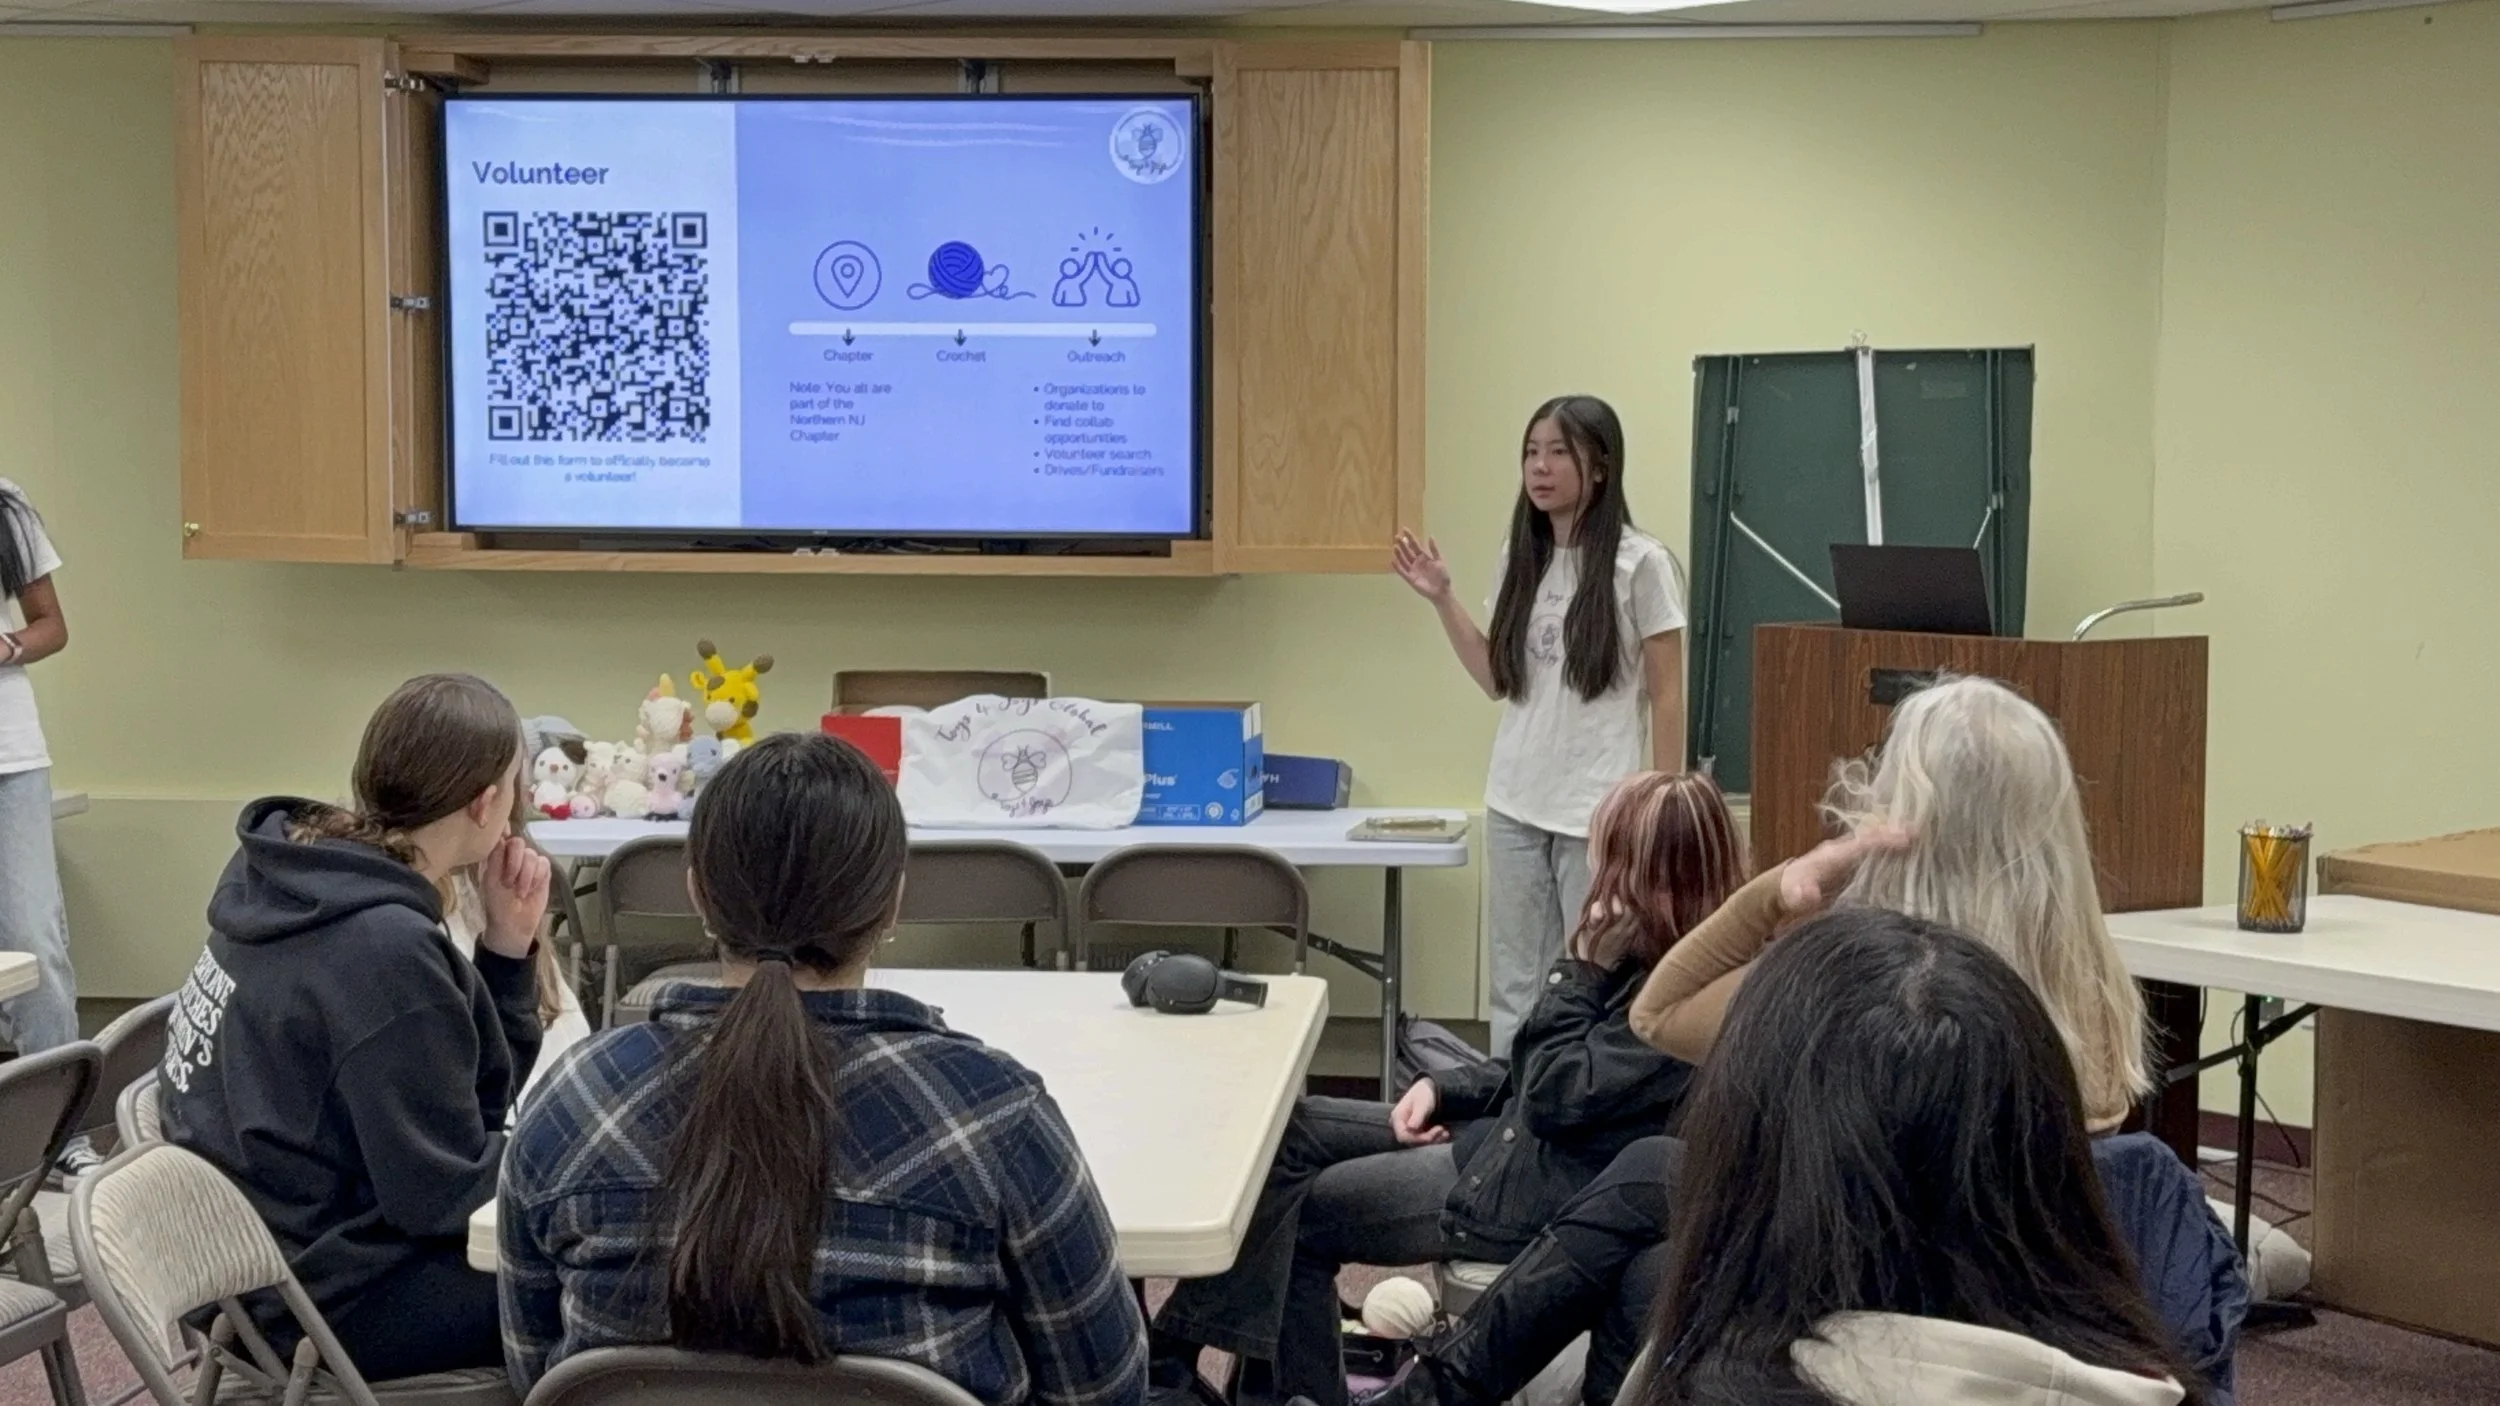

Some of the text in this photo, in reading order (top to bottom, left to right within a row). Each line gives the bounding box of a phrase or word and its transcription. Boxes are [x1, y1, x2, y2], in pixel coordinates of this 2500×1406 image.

[472, 160, 609, 185] Volunteer
[823, 349, 874, 363] Chapter
[936, 350, 986, 363] Crochet
[1067, 350, 1126, 363] Outreach
[825, 382, 851, 394] You
[853, 382, 868, 394] all
[872, 383, 892, 394] are
[1044, 384, 1146, 398] Organizations to
[789, 398, 855, 411] part of the
[1044, 400, 1105, 412] donate to
[789, 414, 865, 426] Northern NJ
[1044, 415, 1114, 428] Find collab
[789, 429, 840, 443] Chapter
[1044, 432, 1128, 446] opportunities
[1044, 448, 1152, 461] Volunteer search
[489, 452, 710, 471] Fill out this form to officially become
[574, 470, 637, 483] volunteer!
[1044, 463, 1165, 477] Drives/Fundraisers
